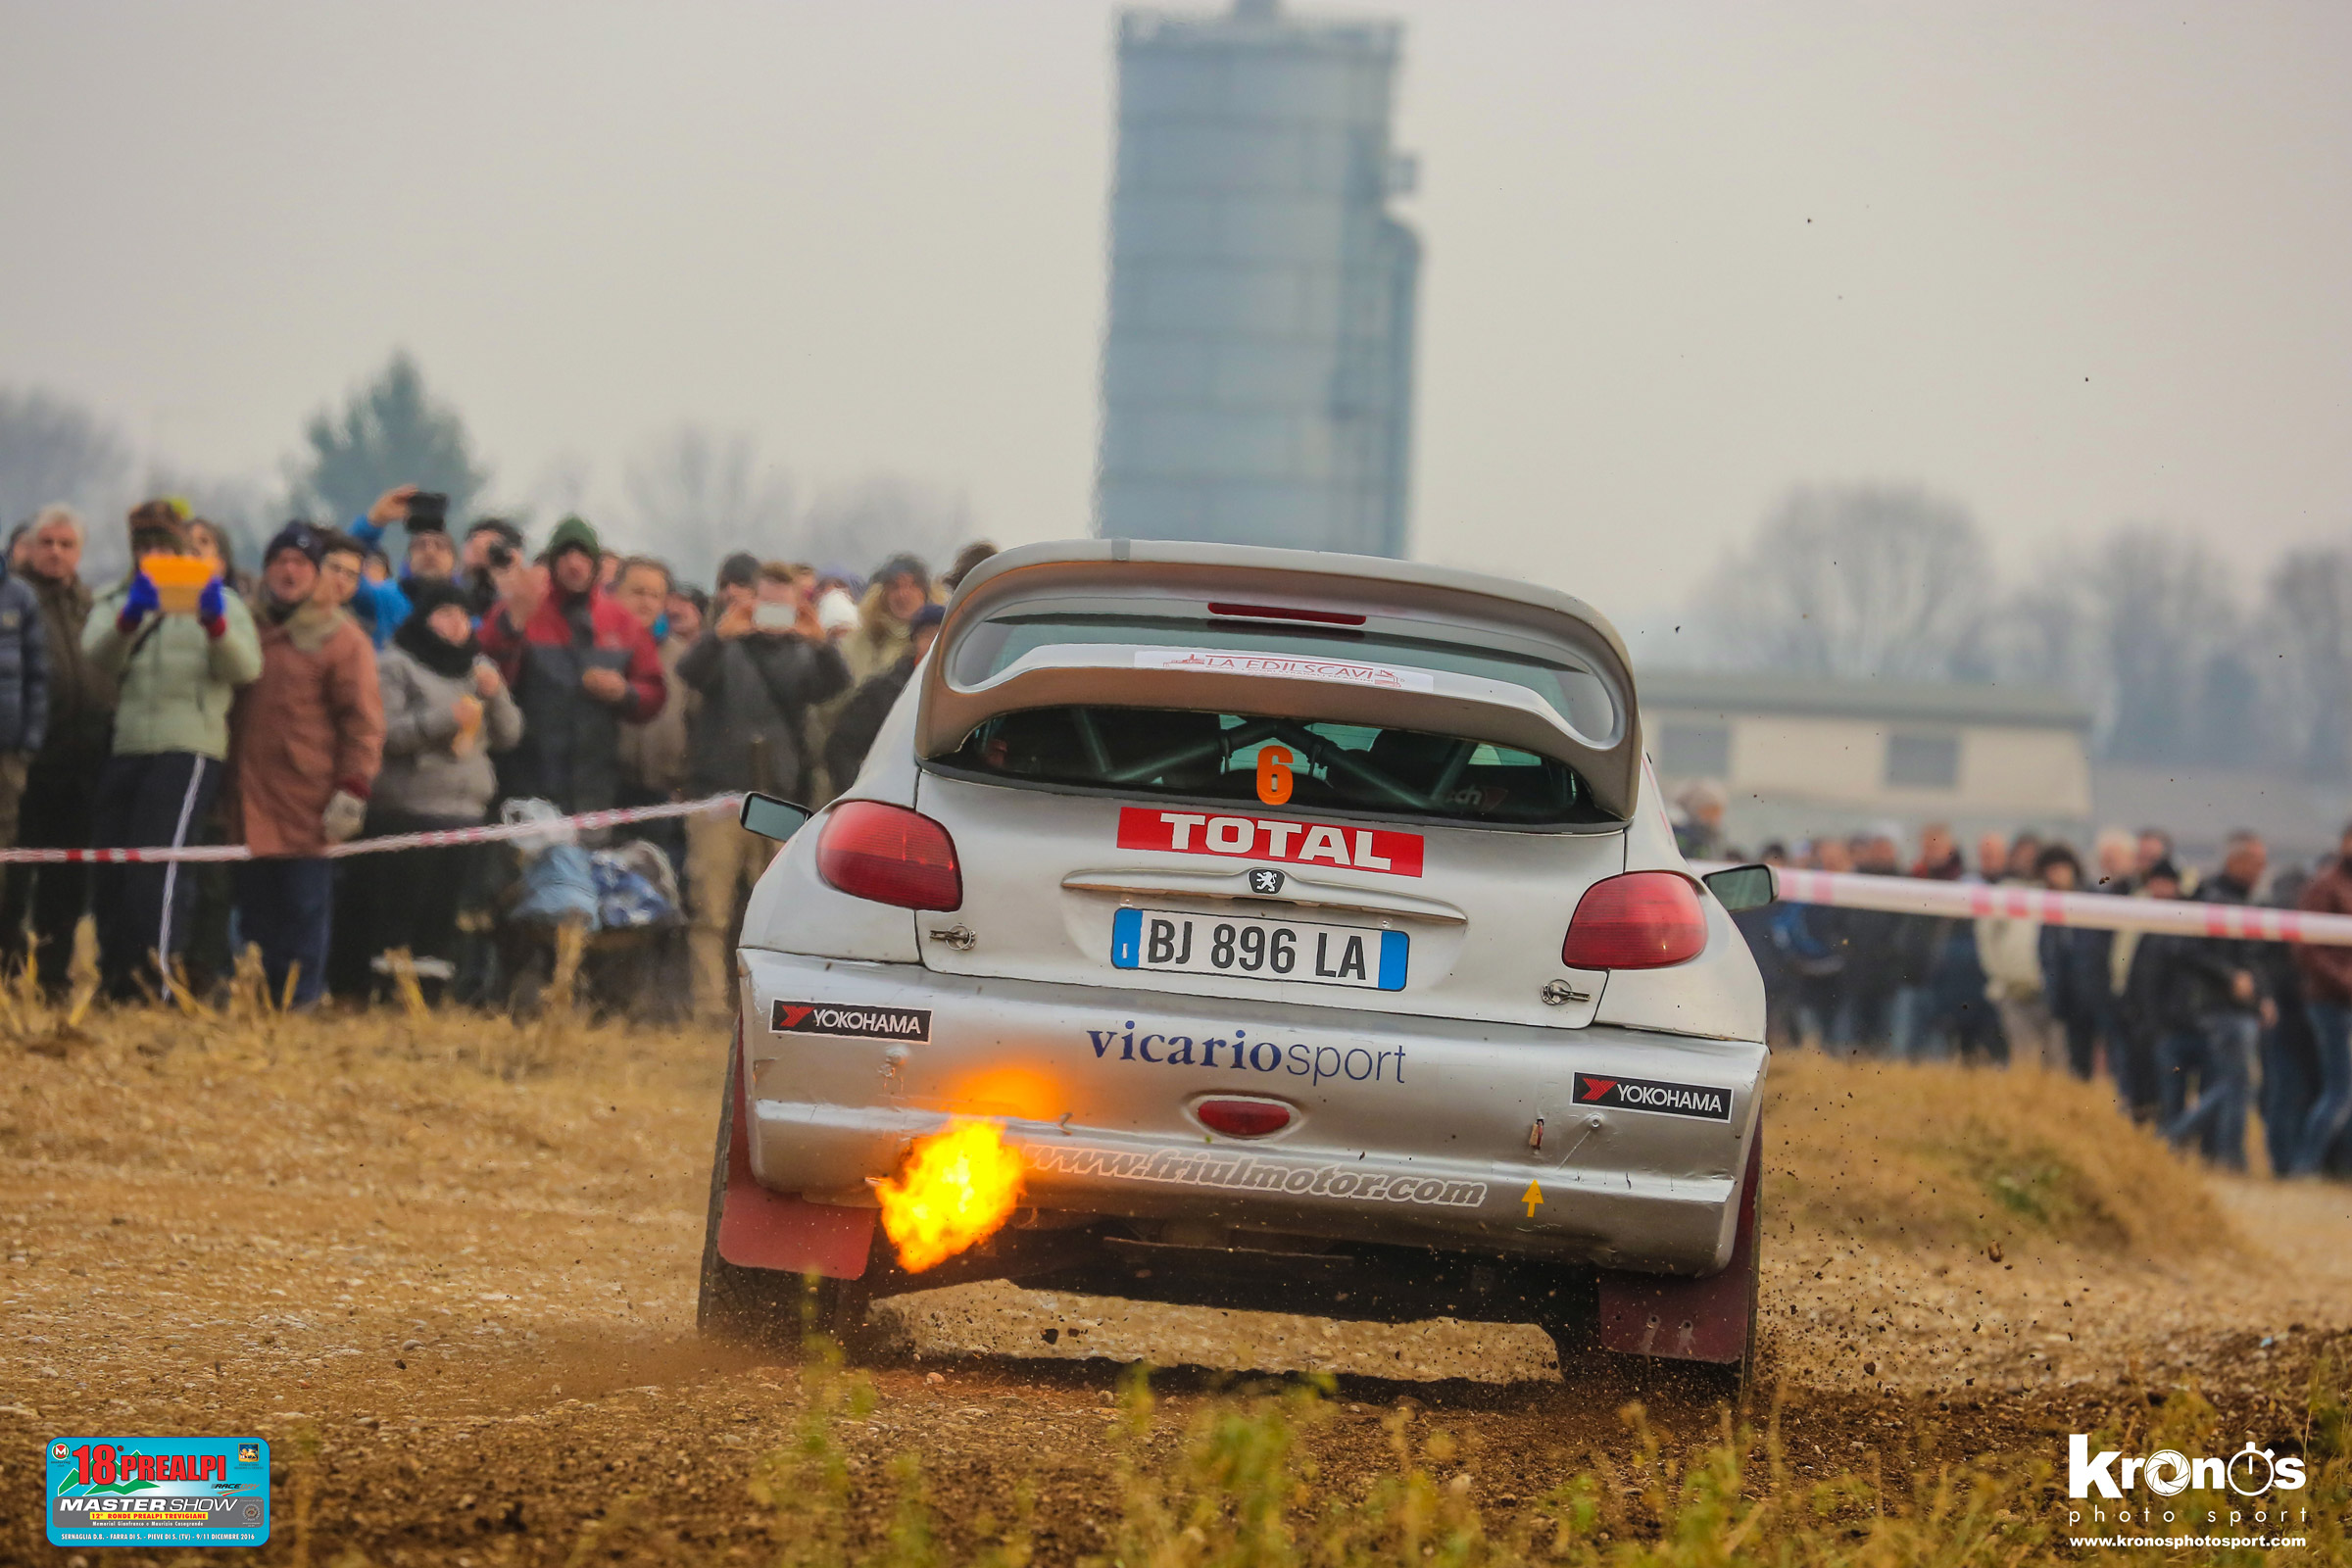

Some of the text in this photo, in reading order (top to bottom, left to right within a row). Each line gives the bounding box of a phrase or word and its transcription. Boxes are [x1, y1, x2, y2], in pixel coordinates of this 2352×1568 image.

[1207, 658, 1235, 667] LA
[1246, 660, 1373, 679] EDILSCAVI
[1256, 745, 1294, 806] 6
[1160, 812, 1392, 871] TOTAL
[1148, 919, 1193, 964] BJ
[1211, 923, 1297, 974] 896
[1315, 932, 1366, 980] LA
[812, 1008, 921, 1035] YOKOHAMA
[1086, 1020, 1406, 1086] vicariosport
[1616, 1083, 1722, 1113] YOKOHAMA
[1023, 1143, 1488, 1208] www.friulmotor.com
